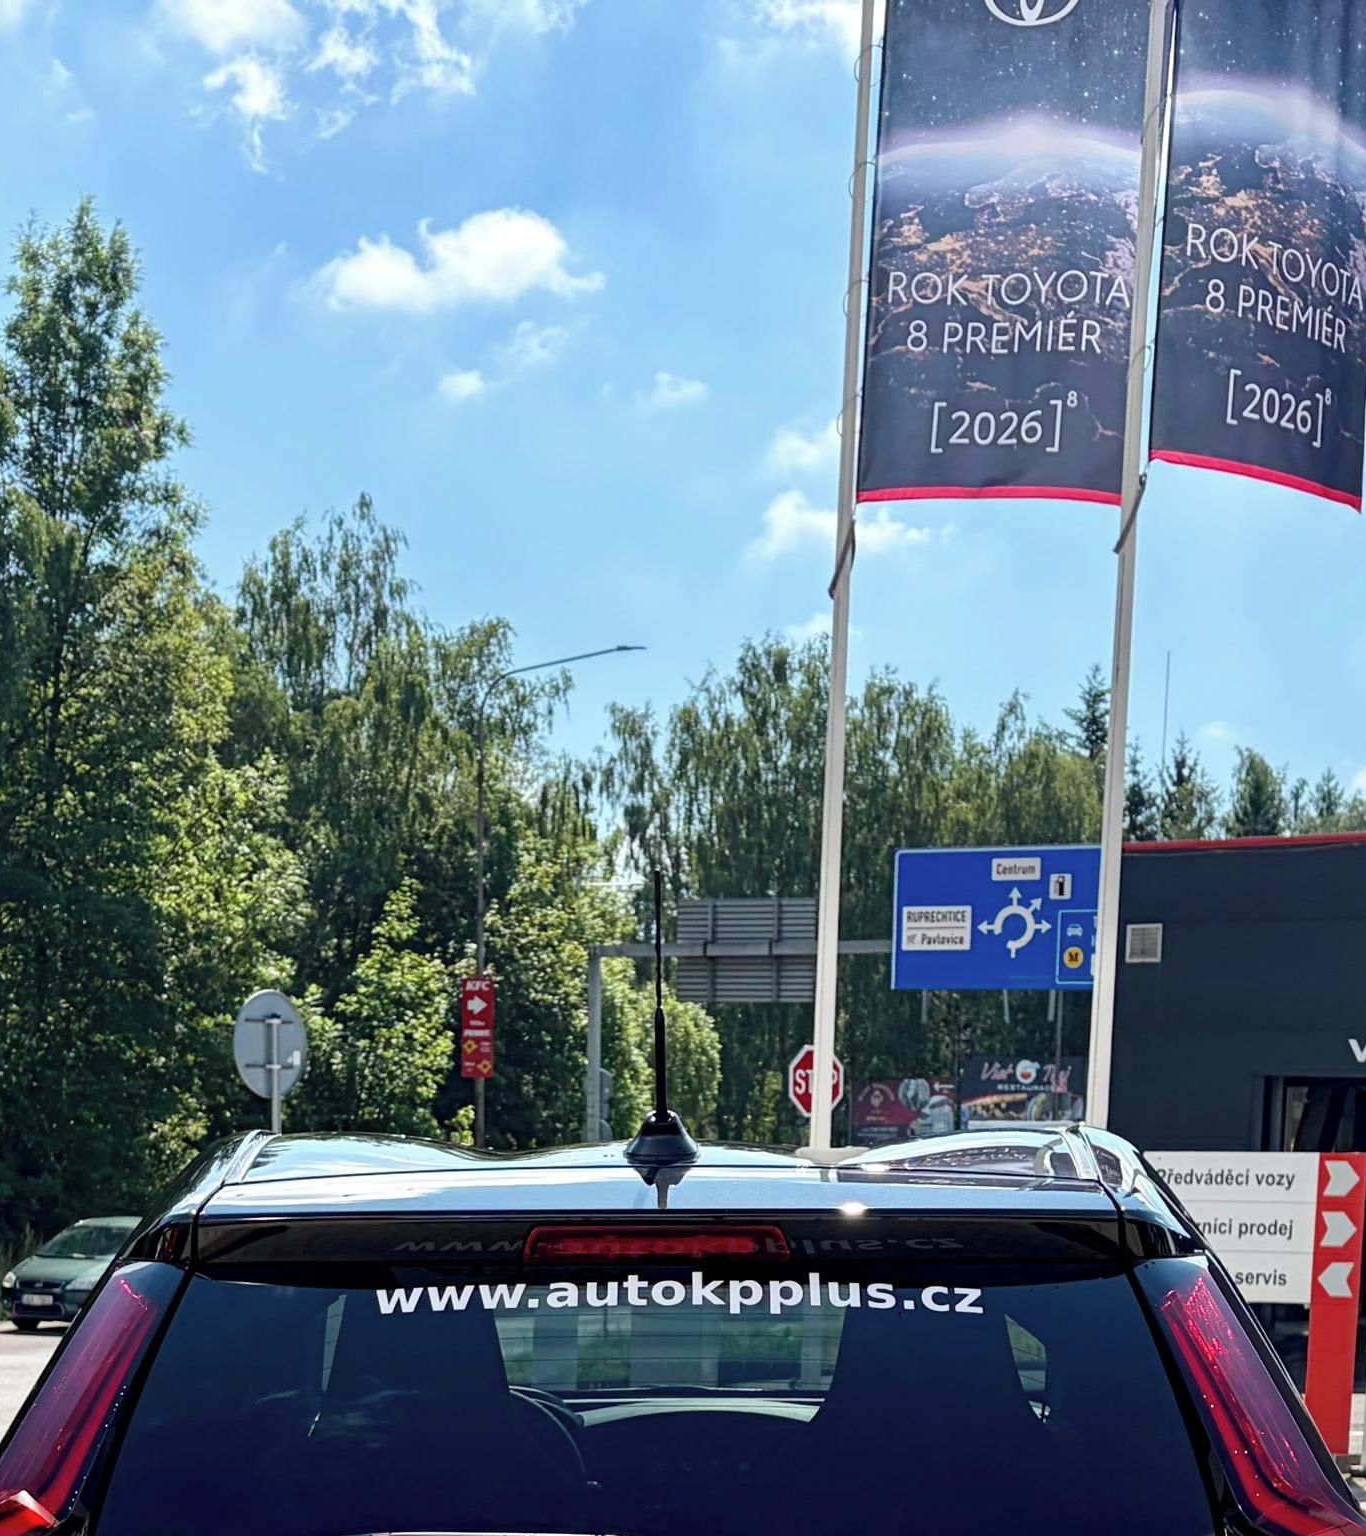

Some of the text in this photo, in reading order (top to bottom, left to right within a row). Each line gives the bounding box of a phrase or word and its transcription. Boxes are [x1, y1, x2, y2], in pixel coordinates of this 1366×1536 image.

[1186, 223, 1364, 312] ROK TOYOTA
[887, 269, 1131, 308] ROK TOYOTA
[1205, 278, 1347, 354] 8 PREMIÉR
[906, 312, 1103, 354] 8 PREMIÉR
[995, 863, 1036, 876] Centrum
[907, 910, 966, 923] RUPRECHTICE
[921, 933, 964, 945] Pavlovice
[466, 981, 491, 991] KFC
[1256, 1173, 1295, 1190] vozy
[1238, 1219, 1294, 1240] prodej
[1235, 1269, 1287, 1286] servis
[376, 1271, 985, 1316] www.autokpplus.cz
